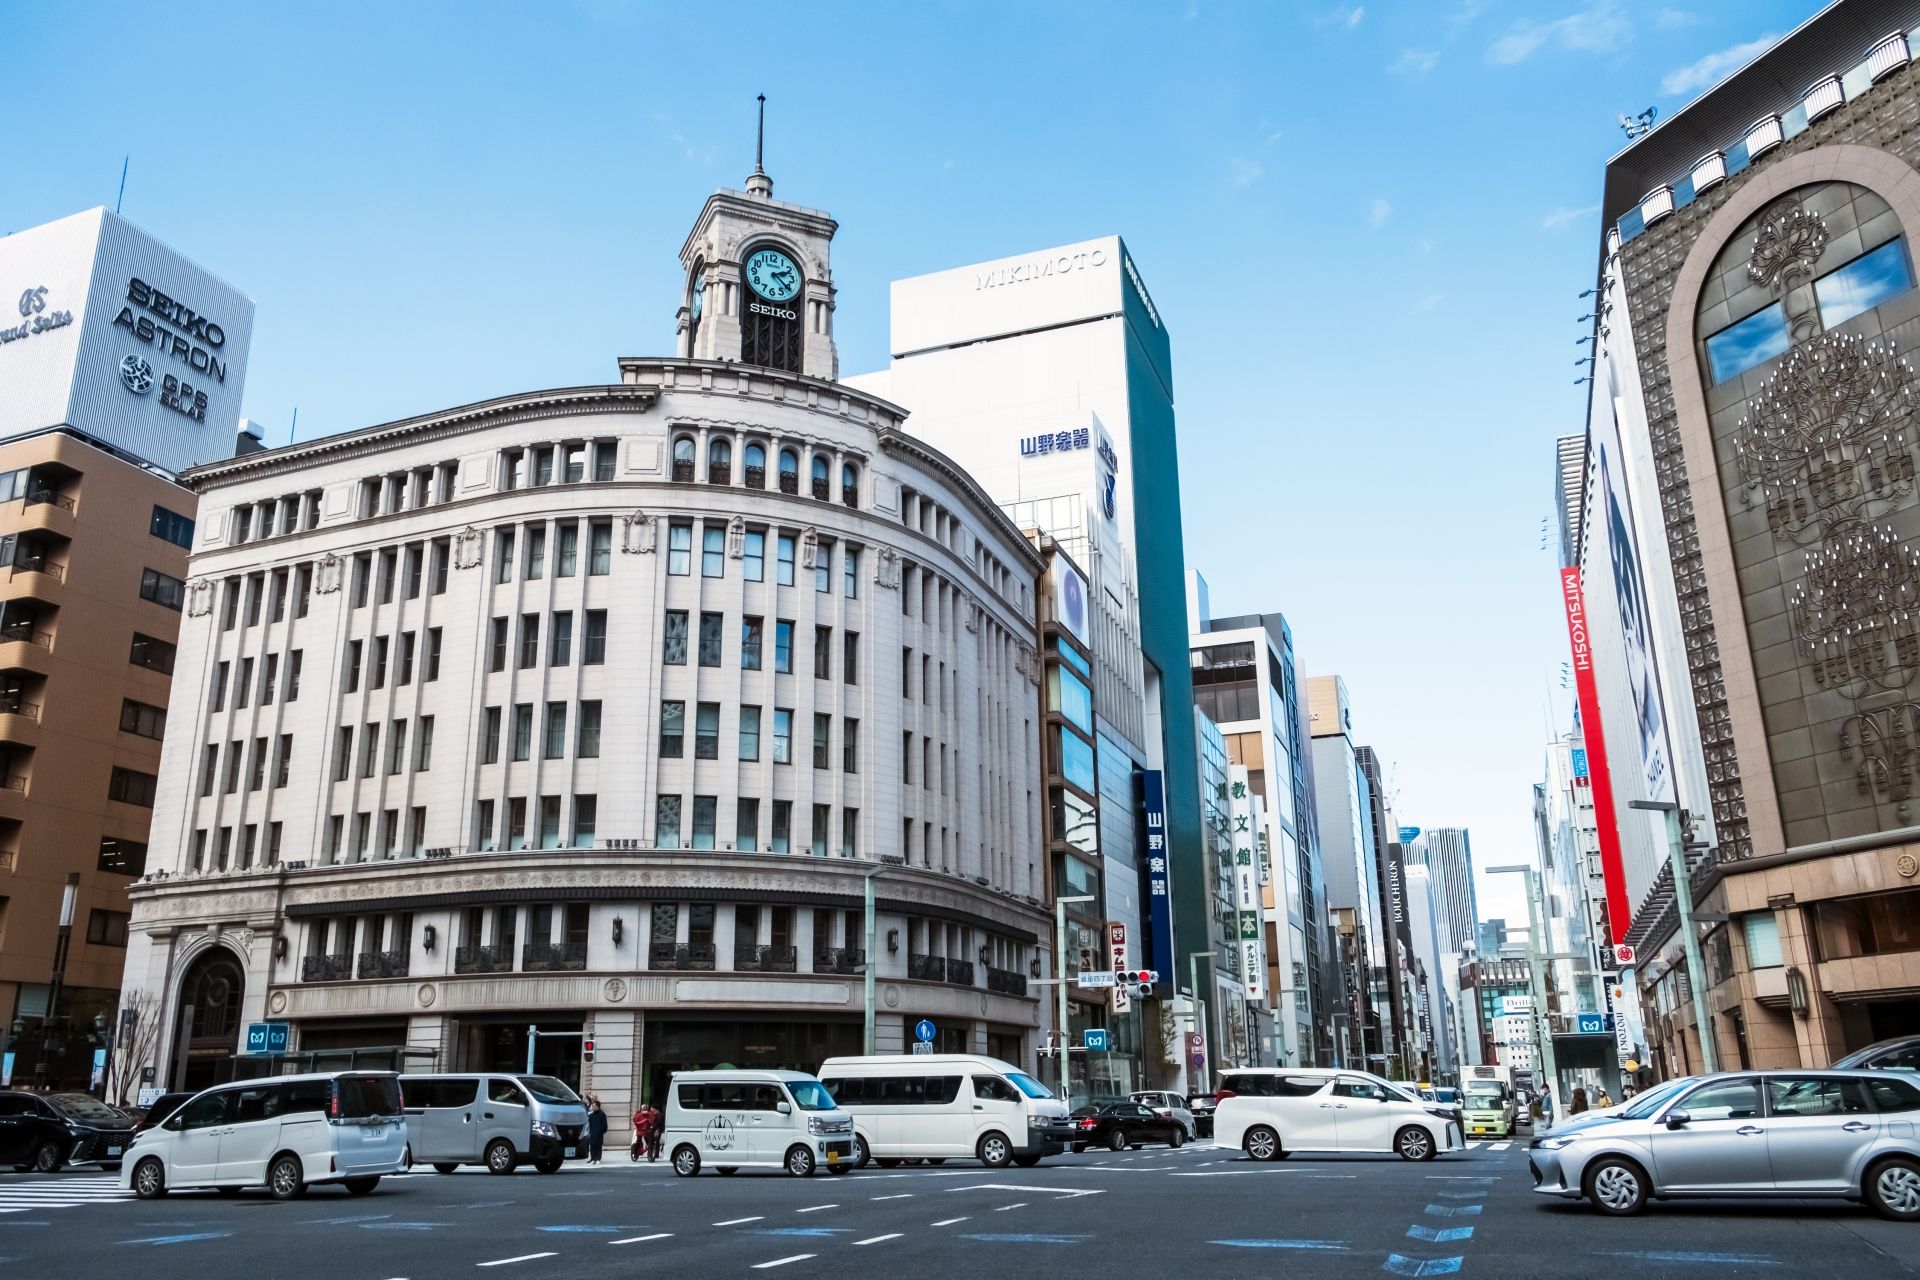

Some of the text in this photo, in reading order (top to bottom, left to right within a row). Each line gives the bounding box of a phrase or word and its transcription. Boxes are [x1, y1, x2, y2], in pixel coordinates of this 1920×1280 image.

[754, 260, 762, 268] 10
[761, 254, 768, 263] 11
[770, 254, 778, 263] 12
[751, 267, 758, 275] 9
[786, 266, 792, 275] 2
[975, 250, 1108, 290] MIKIMOTO
[754, 276, 760, 285] 8
[761, 284, 768, 292] 7
[788, 275, 795, 284] 3
[769, 288, 776, 296] 6
[778, 288, 784, 296] 5
[126, 277, 226, 349] SEIKO
[750, 303, 796, 320] SEIKO
[31, 310, 73, 334] Seiko
[112, 306, 226, 384] ASTRON
[162, 373, 208, 410] GPS
[159, 393, 206, 424] SOLAR
[1021, 428, 1089, 457] 山野楽器
[1564, 574, 1589, 671] MITSUKOSHI
[1231, 781, 1251, 866] 教文館
[1147, 812, 1166, 896] 山野楽器
[1389, 860, 1403, 923] BOUCHERON
[1241, 915, 1256, 935] 本
[704, 1134, 735, 1142] MAVAM
